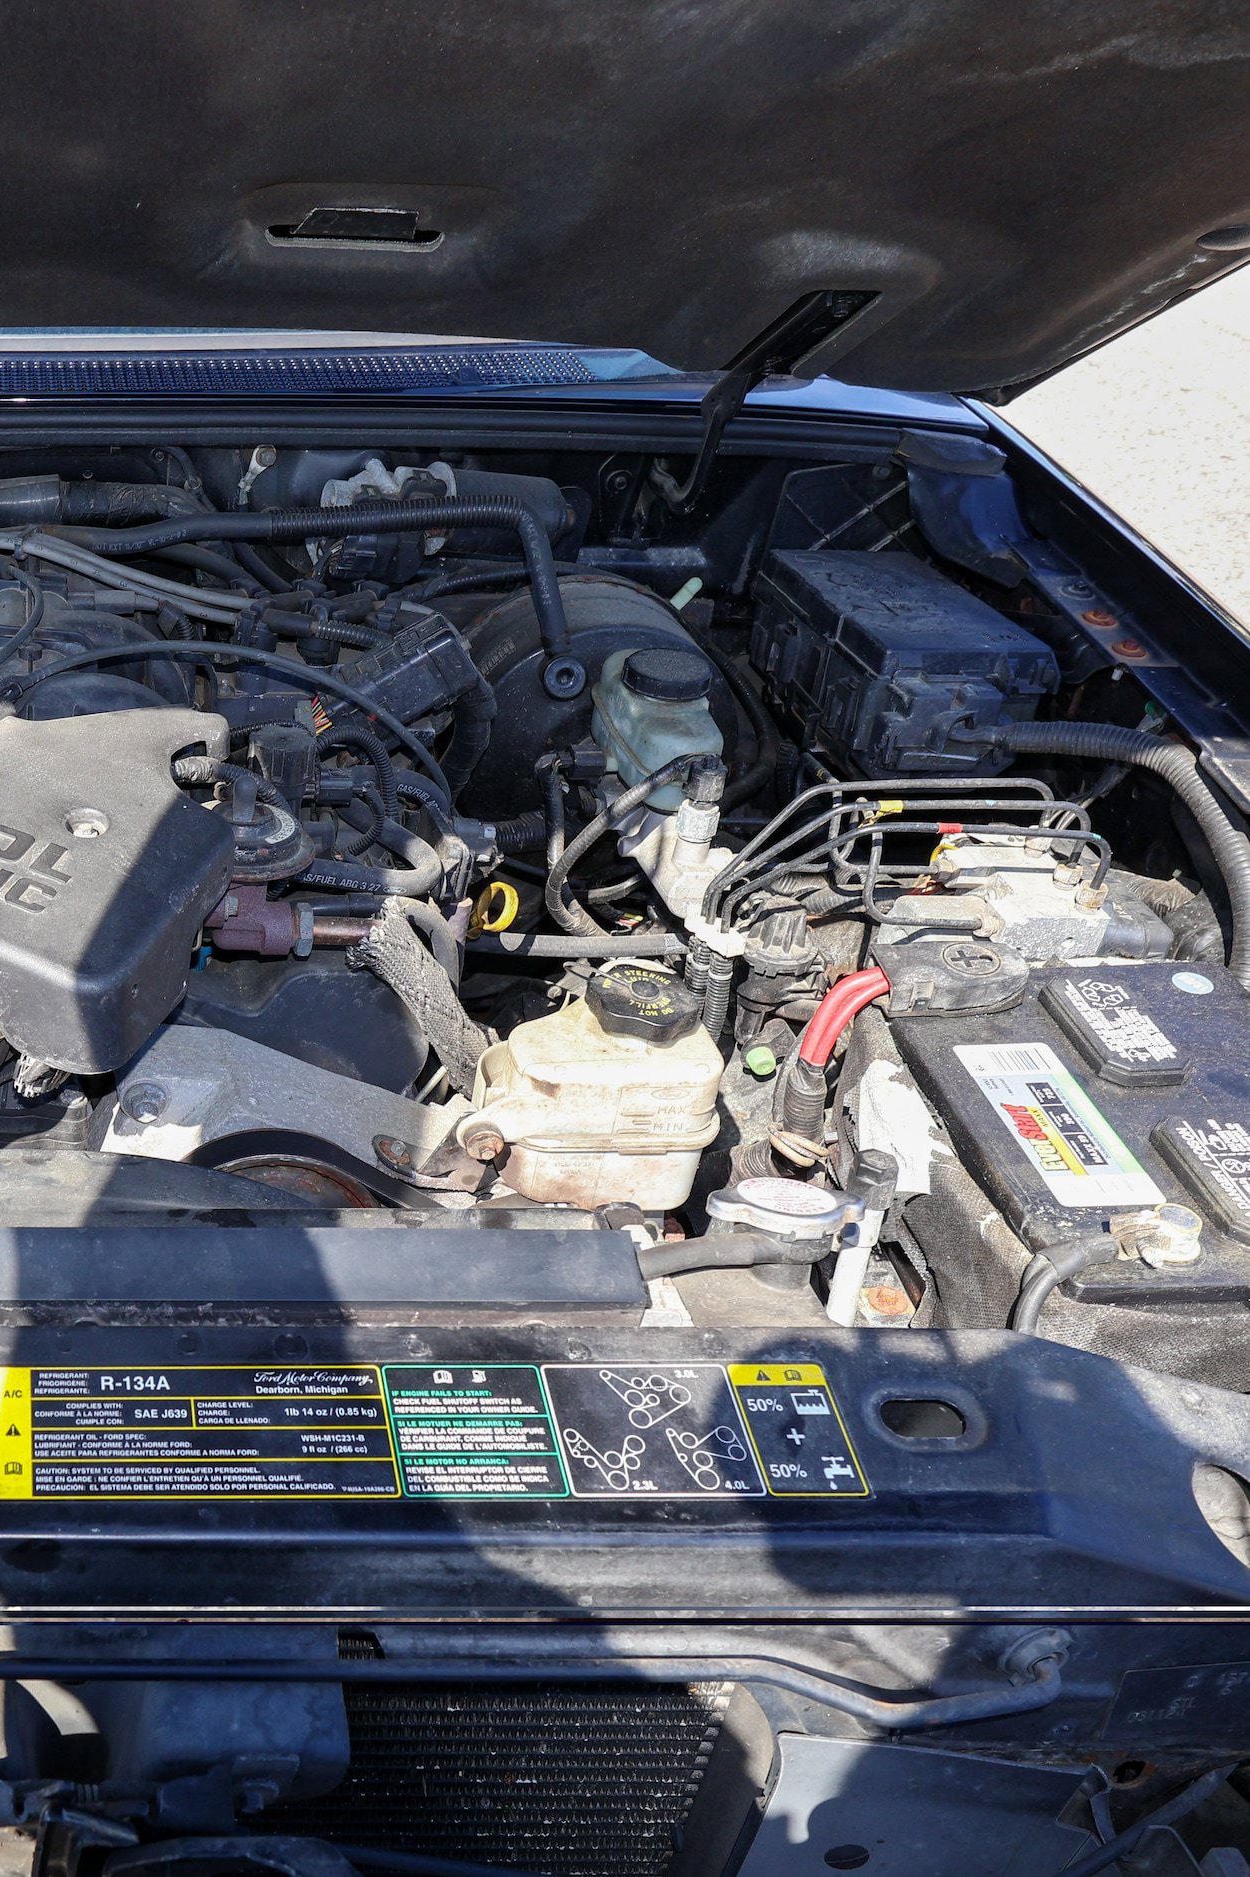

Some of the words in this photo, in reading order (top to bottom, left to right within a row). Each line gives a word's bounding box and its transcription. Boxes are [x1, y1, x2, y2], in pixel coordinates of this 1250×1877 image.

[396, 783, 431, 806] GAS/FUEL
[340, 878, 358, 890] ABG
[360, 879, 367, 890] 3
[368, 881, 381, 892] 27
[623, 969, 672, 985] STEERING
[638, 1009, 659, 1017] NOT
[661, 1007, 674, 1015] DO
[657, 1105, 687, 1115] MAX
[653, 1122, 684, 1132] MIN
[1000, 1102, 1070, 1171] EverStart
[1175, 1127, 1212, 1162] POISON
[1210, 1169, 1250, 1210] DANGER
[253, 1371, 283, 1383] Ford
[278, 1371, 315, 1386] Motor
[673, 1369, 699, 1379] 3.0L
[100, 1375, 170, 1391] R-134A
[4, 1389, 23, 1398] A/C
[255, 1385, 303, 1394] Dearborn,
[305, 1385, 348, 1395] Michigan
[66, 1402, 102, 1410] COMPLIES
[197, 1401, 227, 1409] CHARGE
[229, 1401, 253, 1409] LEVEL:
[747, 1398, 784, 1412] 50%
[34, 1410, 74, 1418] CONFORME
[134, 1409, 159, 1419] SAE
[161, 1409, 188, 1419] J639
[302, 1407, 313, 1416] 14
[335, 1407, 359, 1418] (0.85
[361, 1407, 378, 1418] kg)
[34, 1433, 85, 1441] REFRIGERANT
[85, 1433, 98, 1441] OIL
[103, 1433, 124, 1441] FORD
[301, 1434, 365, 1442] WSH-M1C231-B
[34, 1441, 76, 1449] LUBRIFIANT
[82, 1441, 123, 1449] CONFORME
[302, 1445, 307, 1453] 9
[309, 1445, 315, 1453] fl
[335, 1445, 353, 1454] (266
[354, 1445, 368, 1454] cc)
[34, 1449, 49, 1457] USE
[50, 1449, 76, 1457] ACEITE
[78, 1449, 97, 1457] PARA
[99, 1449, 159, 1457] REFRIGERANTES
[35, 1467, 70, 1475] CAUTION:
[769, 1463, 808, 1479] 50%
[35, 1475, 54, 1483] MISE
[55, 1475, 65, 1483] EN
[66, 1475, 94, 1483] GARDE
[249, 1483, 288, 1491] PERSONAL
[632, 1480, 659, 1491] 2.3L
[724, 1480, 750, 1490] 4.0L
